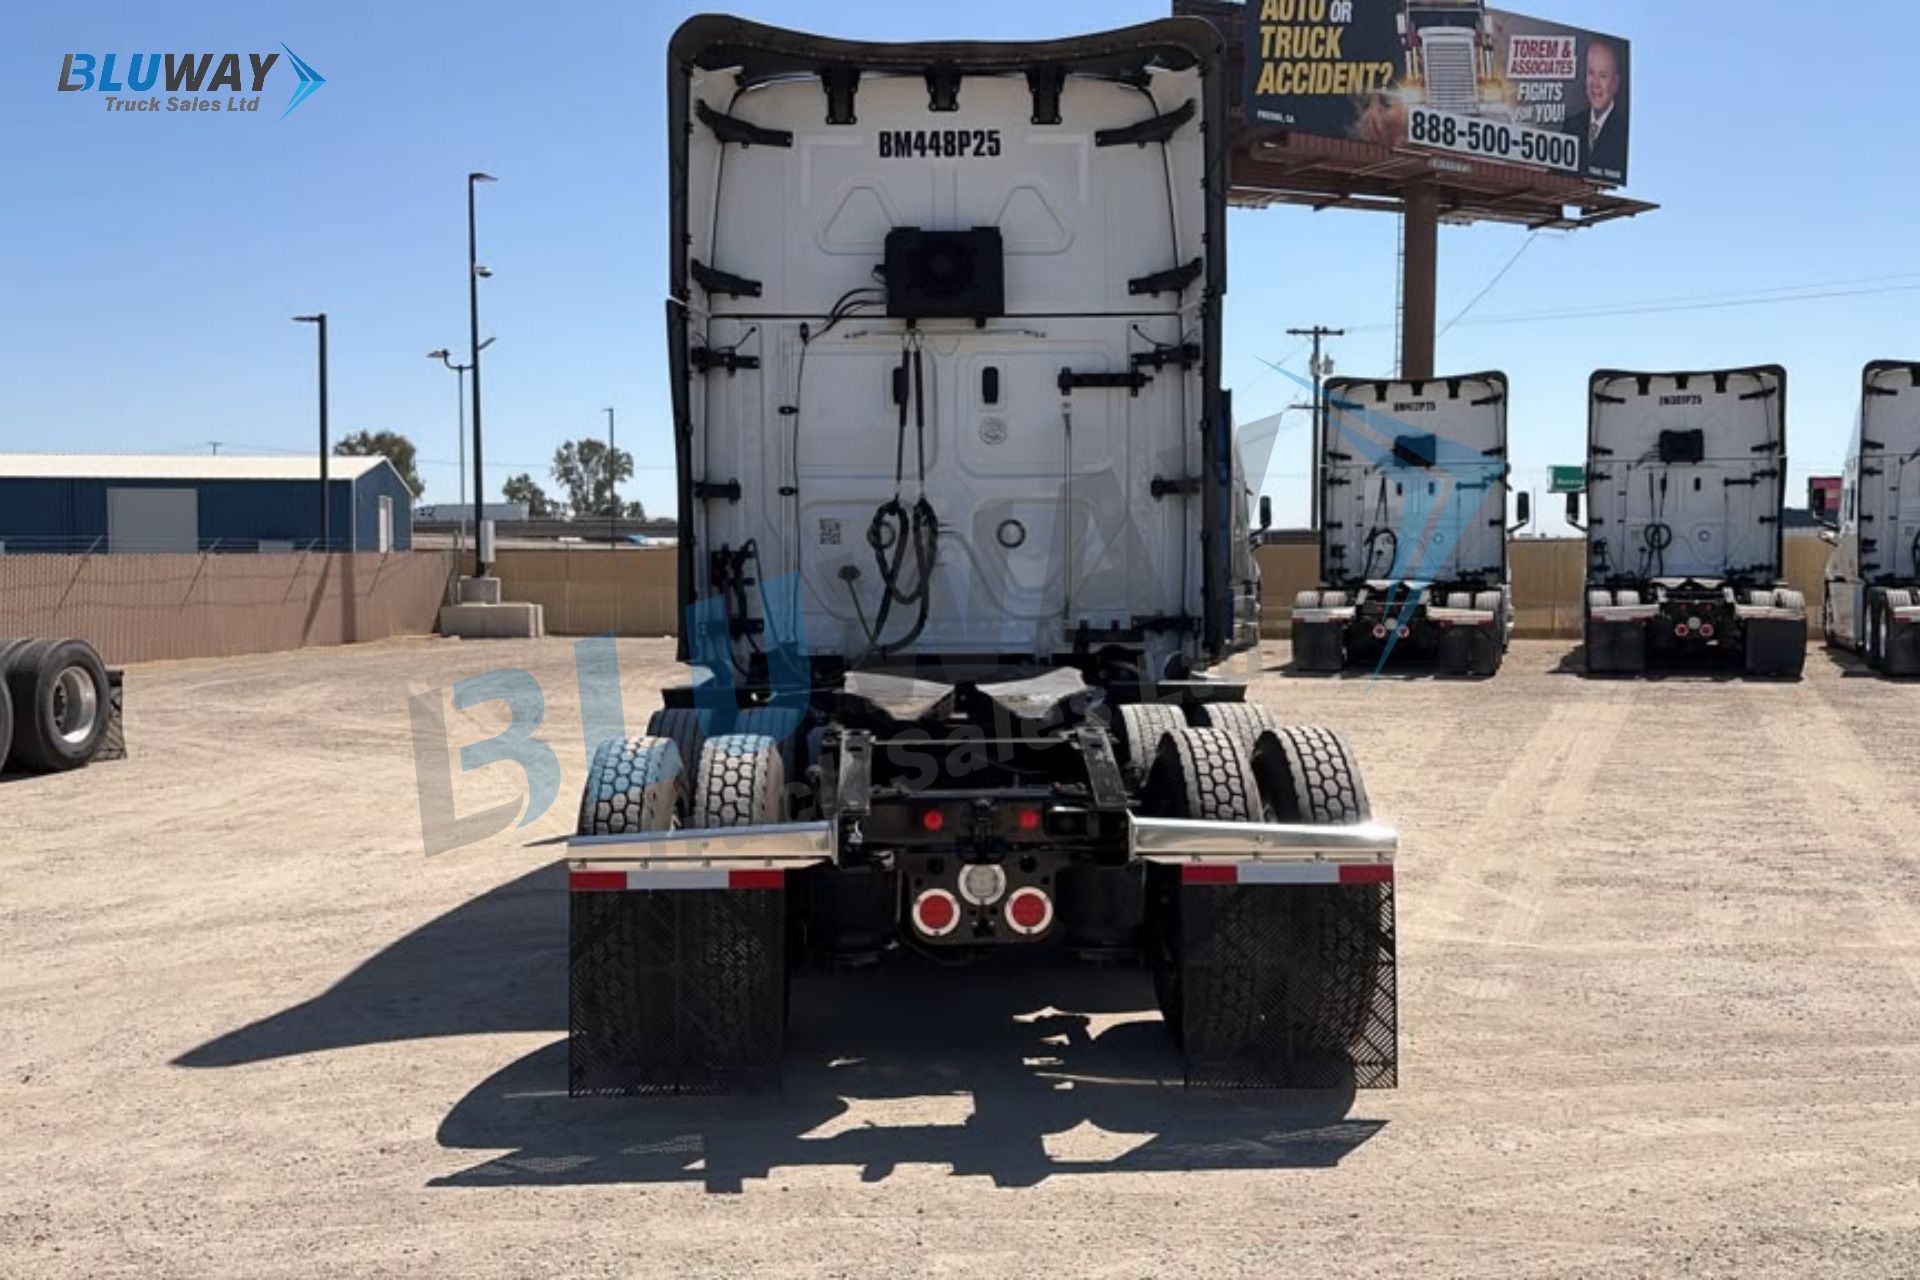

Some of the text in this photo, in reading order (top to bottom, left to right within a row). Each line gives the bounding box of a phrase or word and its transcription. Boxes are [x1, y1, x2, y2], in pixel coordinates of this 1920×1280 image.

[1260, 0, 1352, 23] AUTO OR
[1260, 26, 1344, 58] TRUCK
[1513, 39, 1572, 58] TOREM &
[1255, 62, 1393, 95] ACCIDENT?
[1511, 59, 1574, 75] ASSOCIATES
[1517, 82, 1564, 102] FIGHTS
[1536, 104, 1565, 122] YOU!
[879, 130, 1001, 158] BM448P25
[1411, 110, 1577, 167] 888-500-5000
